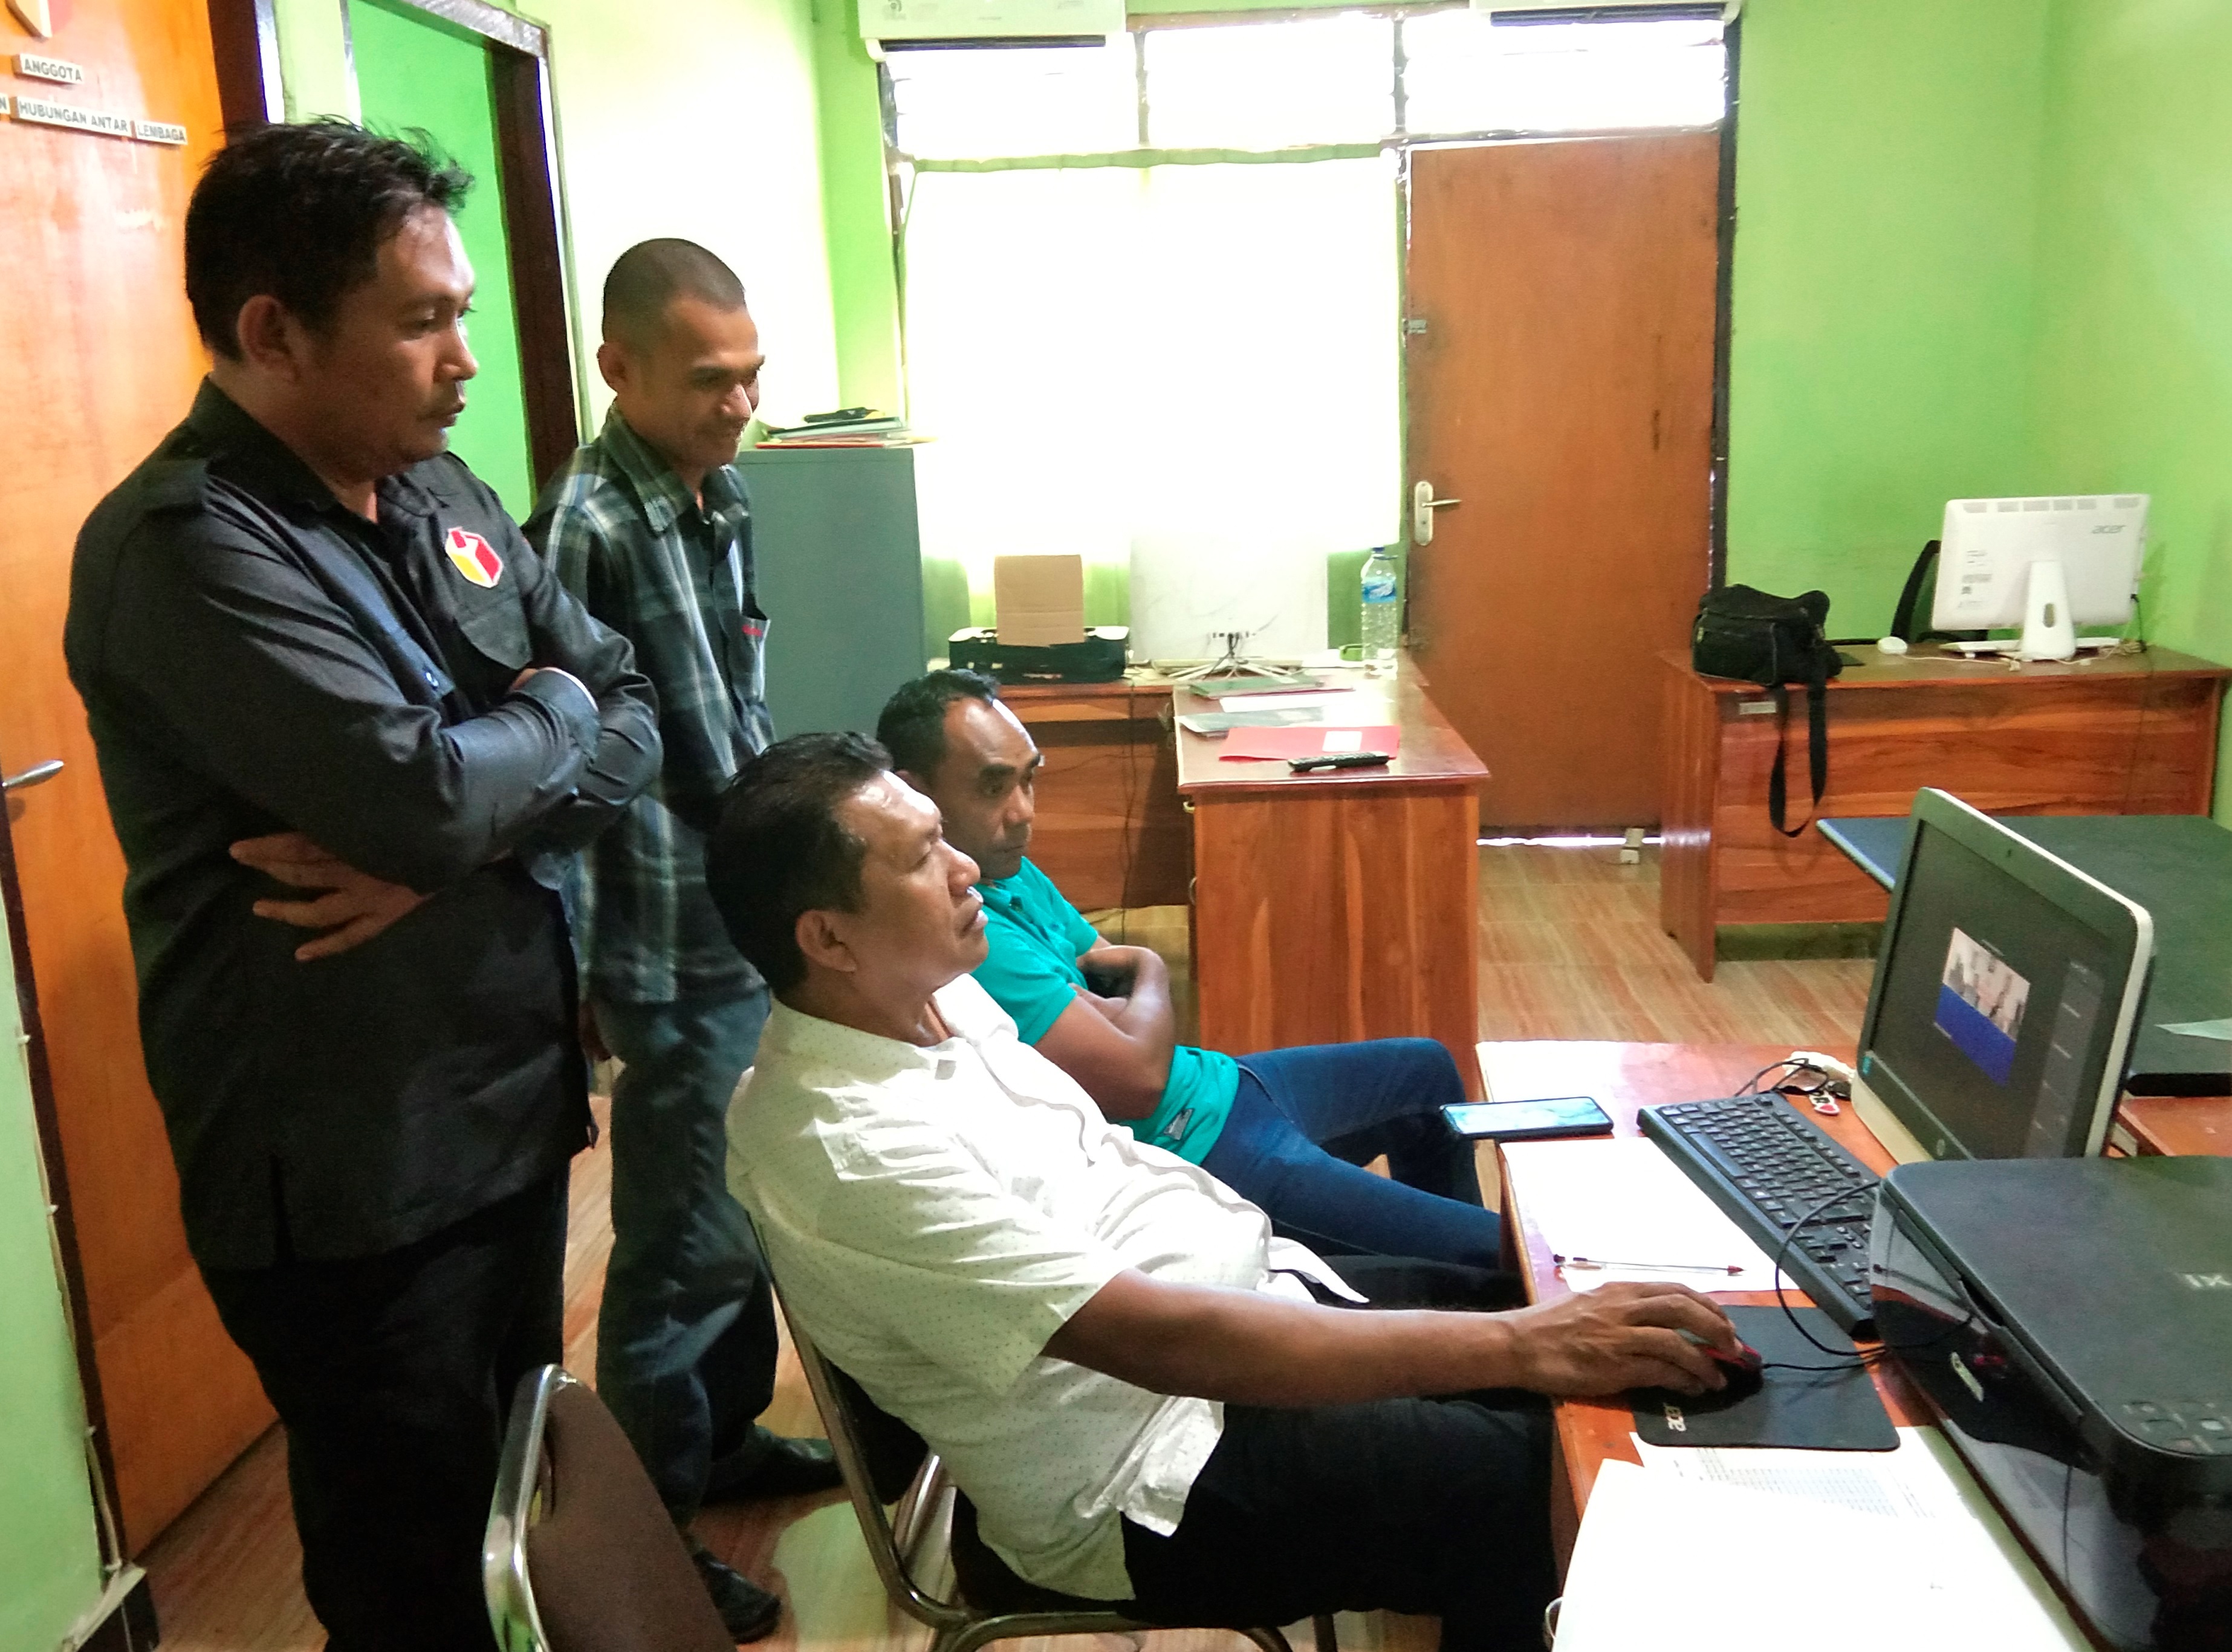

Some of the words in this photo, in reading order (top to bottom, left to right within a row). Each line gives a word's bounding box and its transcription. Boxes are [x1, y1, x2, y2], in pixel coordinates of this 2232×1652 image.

[24, 59, 82, 82] ANGGOTA
[19, 100, 86, 124] HUBUNGAN
[91, 115, 128, 132] ANTAR
[137, 125, 186, 143] LEMBAGA
[2091, 523, 2127, 534] acer
